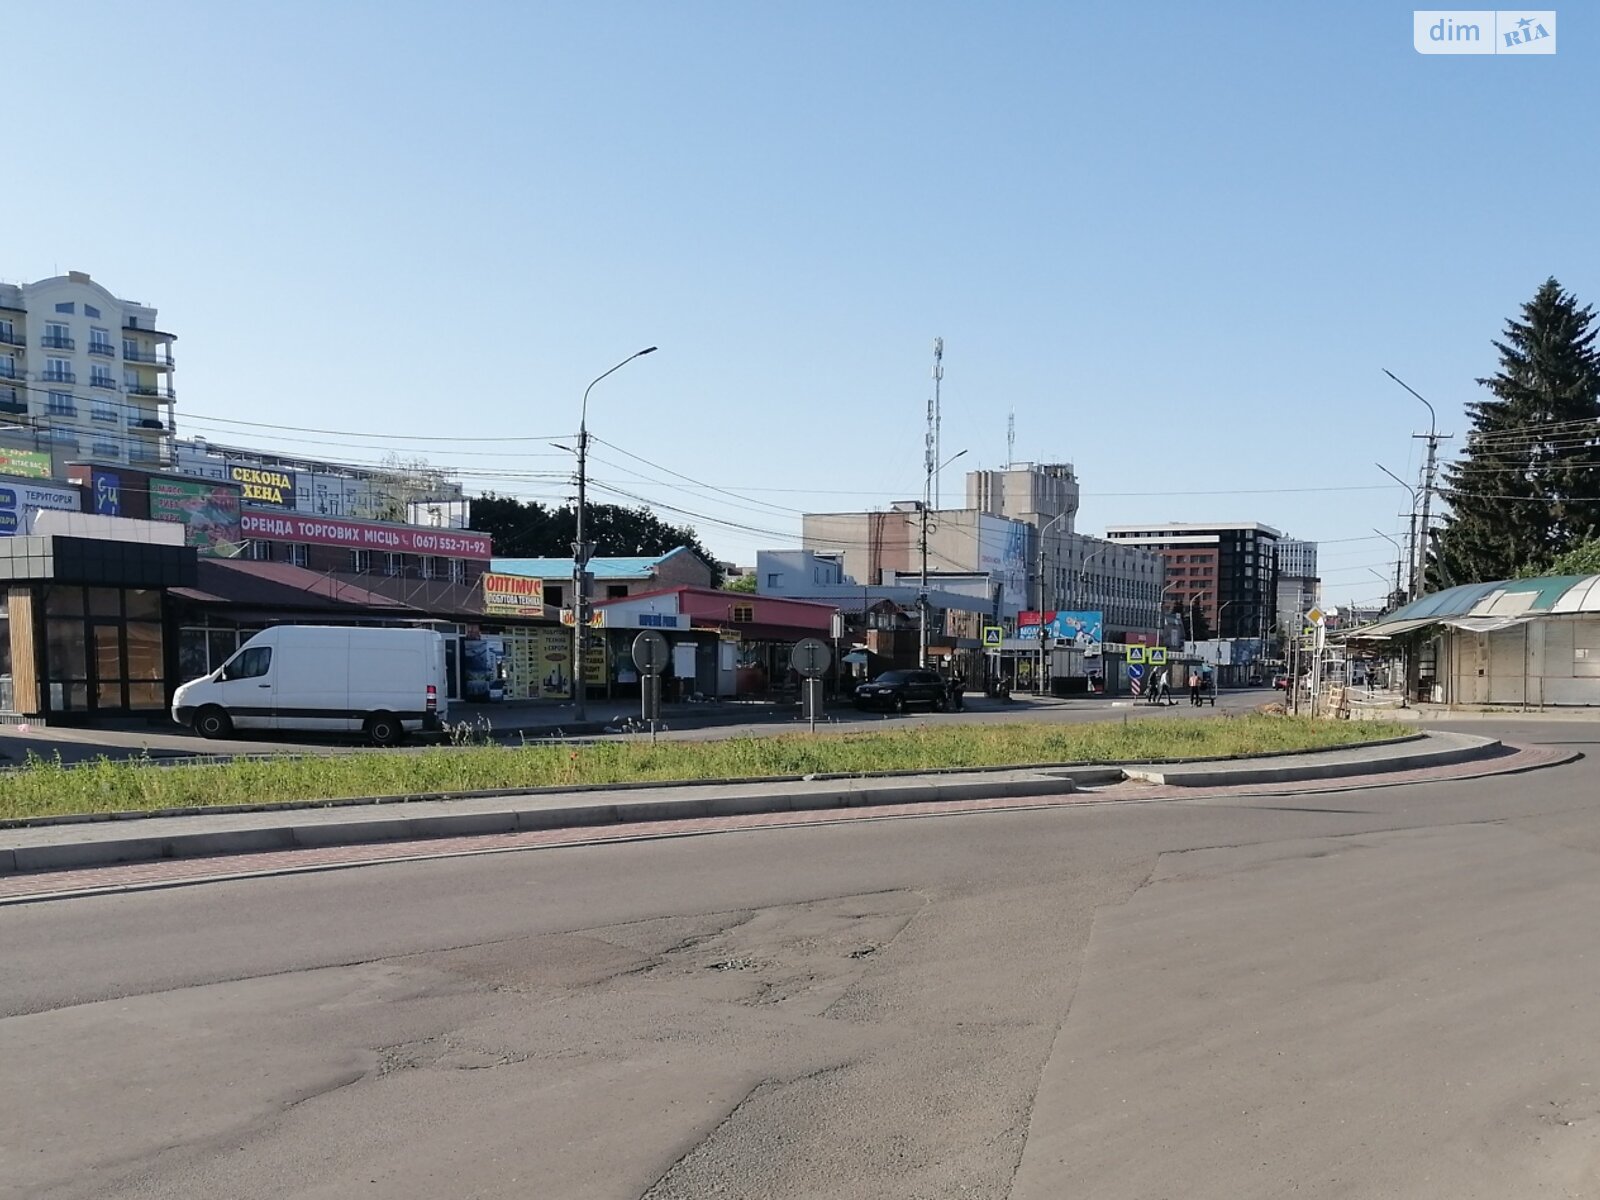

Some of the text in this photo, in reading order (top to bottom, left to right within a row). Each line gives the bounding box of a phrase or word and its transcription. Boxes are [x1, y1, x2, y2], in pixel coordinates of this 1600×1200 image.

[232, 467, 292, 490] СЕКОНД
[25, 490, 73, 504] ТЕРИТОРІЯ
[243, 484, 283, 504] ХЕНД
[241, 516, 486, 553] ОРЕНДА ТОРГОВИХ МІСЦЬ (067) 552-71-92
[486, 575, 541, 596] ОПТІМУС
